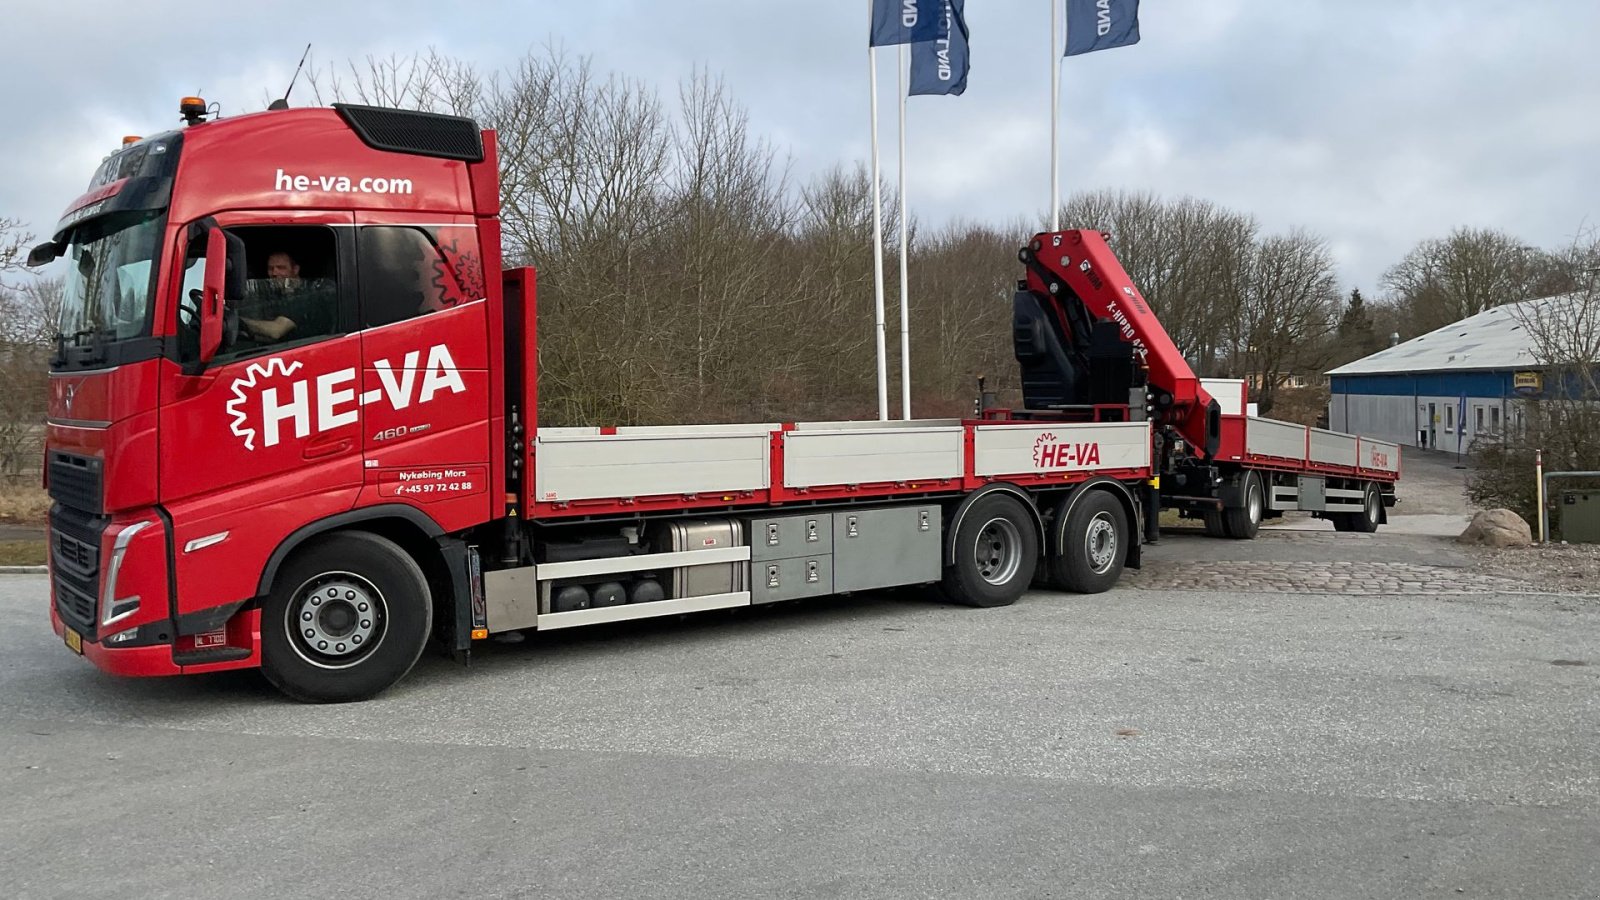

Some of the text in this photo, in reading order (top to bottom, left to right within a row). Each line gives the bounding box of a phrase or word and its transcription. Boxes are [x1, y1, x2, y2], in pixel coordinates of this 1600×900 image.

[275, 168, 413, 194] he-va.com
[1106, 300, 1135, 339] X-HIPRO
[261, 343, 467, 448] HE-VA
[373, 425, 407, 441] 460
[1040, 442, 1101, 468] HE-VA
[399, 469, 467, 482] Nykøbing Mors
[405, 481, 472, 493] +45 97 72 42 88
